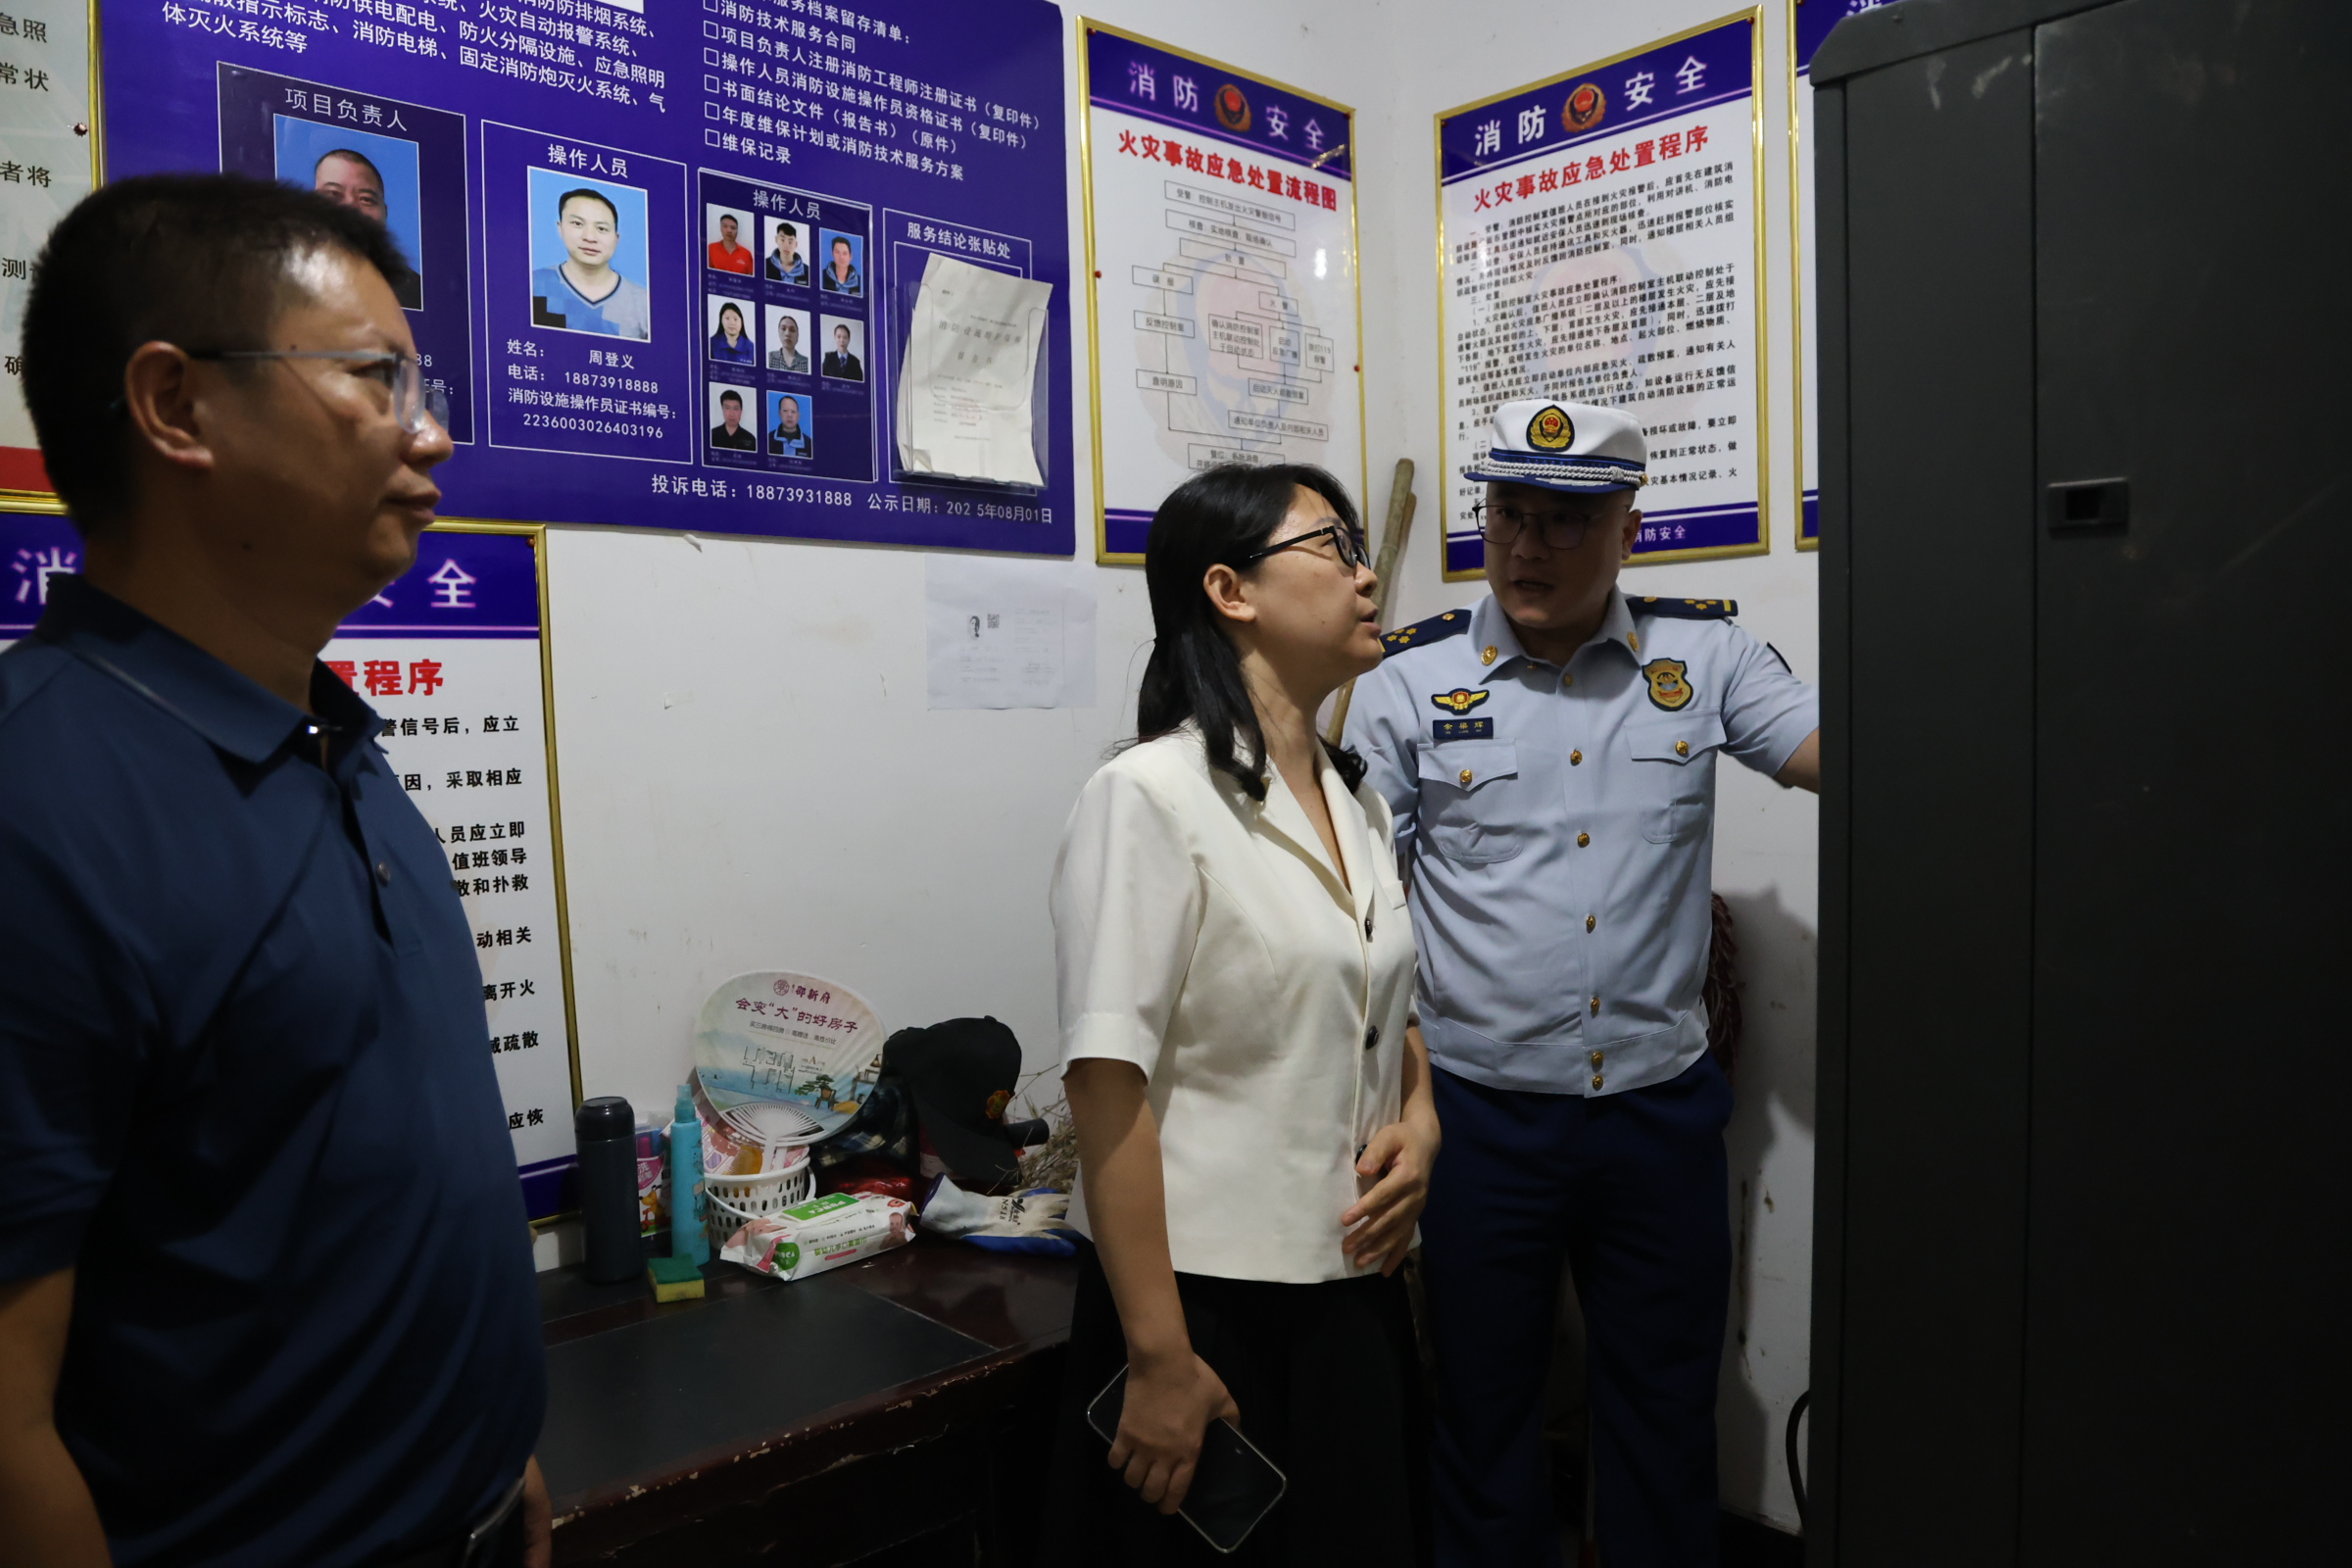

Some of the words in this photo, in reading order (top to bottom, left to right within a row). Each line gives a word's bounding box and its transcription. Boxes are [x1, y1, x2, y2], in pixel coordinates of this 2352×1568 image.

[163, 1, 308, 54] 体灭火系统等
[423, 0, 638, 57] 统、火灾自动报警系统、
[720, 1, 856, 54] 消防技术服务合同
[762, 0, 909, 44] 务档案留存清单：
[205, 0, 666, 113] 指示标志、消防电梯、固定消防炮灭火系统、气
[720, 25, 1040, 129] 项目负责人注册消防工程师注册证书（复印件）
[284, 87, 408, 132] 项目负责人
[721, 52, 1026, 149] 操作人员消防设施操作员资格证书（复印件）
[1129, 61, 1199, 113] 消防
[1265, 105, 1325, 149] 安全
[1475, 105, 1546, 157] 消防
[1624, 56, 1707, 111] 安全
[548, 143, 628, 179] 操作人员
[722, 106, 964, 181] 年度维保计划或消防技术服务方案
[722, 132, 792, 164] 维保记录
[1118, 128, 1338, 212] 火灾事故应急处置流程图
[1473, 124, 1709, 213] 火灾事故应急处置程序
[753, 189, 821, 220] 操作人员
[906, 221, 1011, 260] 服务结论张贴处
[507, 338, 545, 358] 姓名：
[588, 349, 635, 370] 周登义
[508, 363, 545, 381] 电话：
[564, 370, 659, 394] 18873918888
[508, 387, 677, 419] 消防设施操作员证书编号：
[522, 413, 664, 439] 2236003026403196
[1646, 465, 1737, 487] 灾基本情况记录、火
[394, 767, 522, 792] 因，采取相应
[452, 847, 527, 871] 值班领导
[476, 926, 532, 949] 动相关
